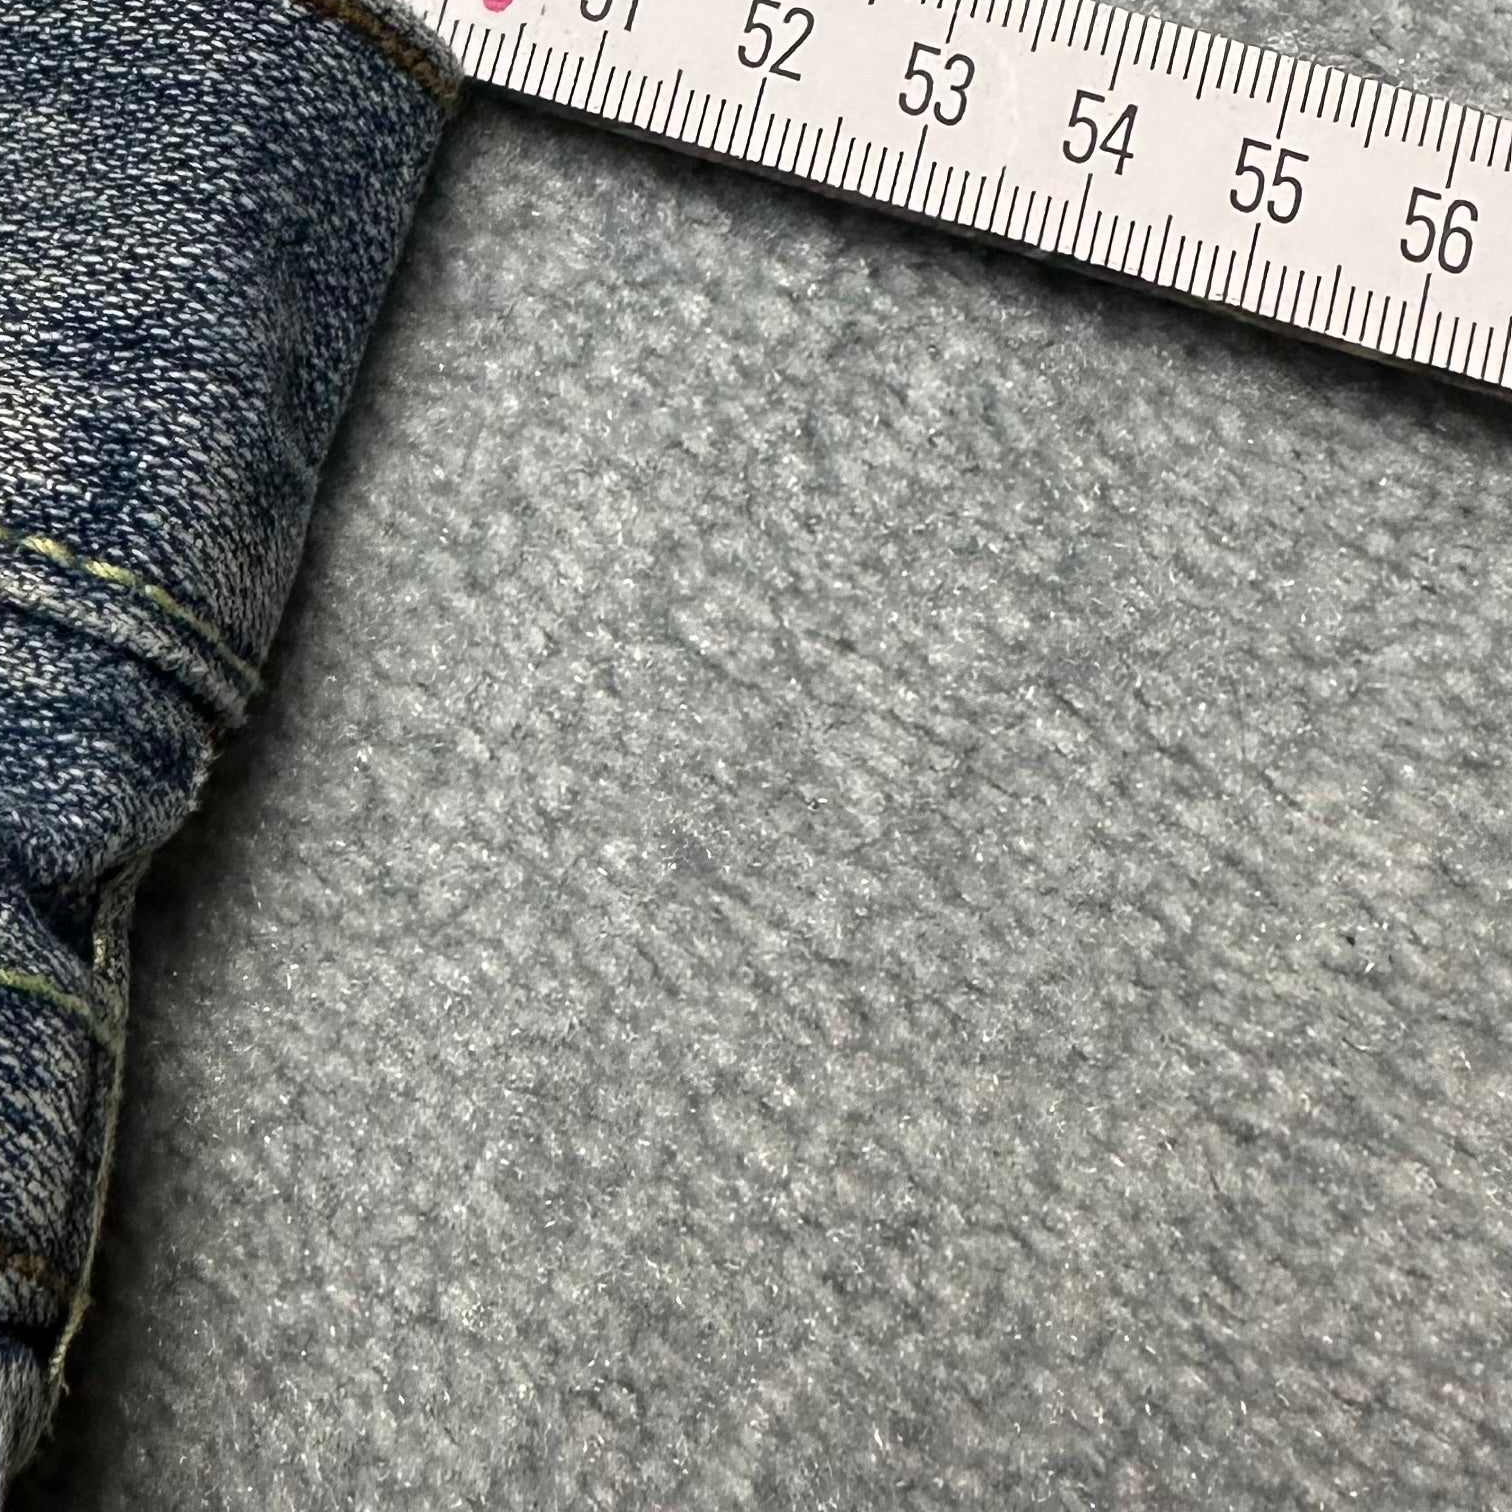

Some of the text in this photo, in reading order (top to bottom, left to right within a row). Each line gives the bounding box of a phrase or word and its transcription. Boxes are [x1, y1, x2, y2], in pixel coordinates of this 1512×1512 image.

[898, 41, 975, 126] 53
[1062, 89, 1138, 175] 54
[1230, 137, 1309, 224] 55
[1399, 186, 1479, 274] 56
